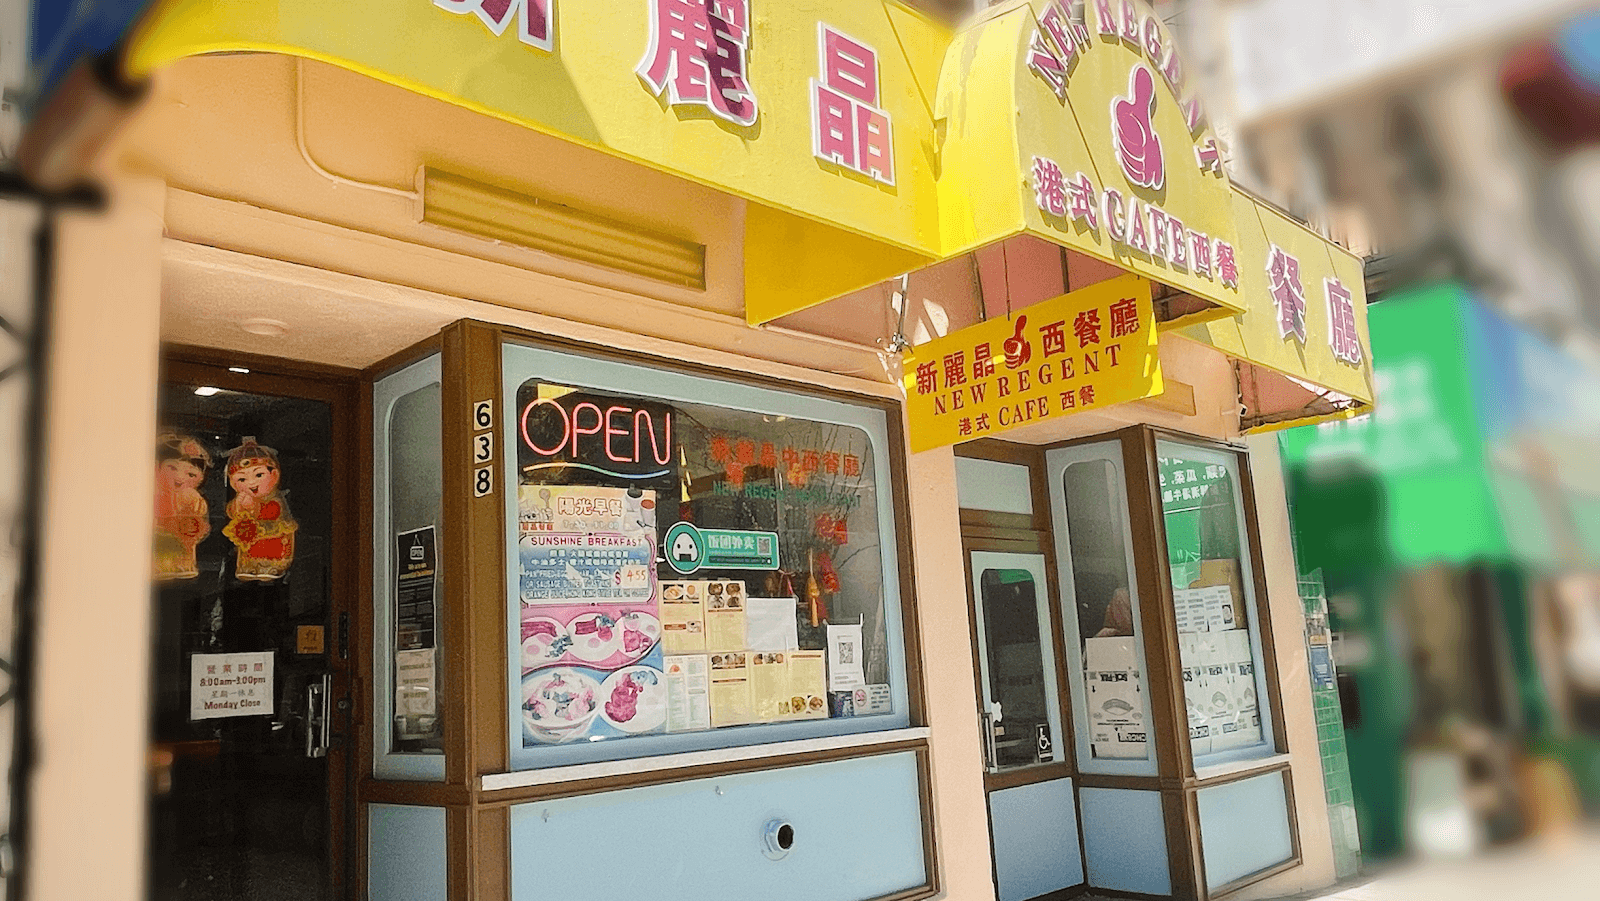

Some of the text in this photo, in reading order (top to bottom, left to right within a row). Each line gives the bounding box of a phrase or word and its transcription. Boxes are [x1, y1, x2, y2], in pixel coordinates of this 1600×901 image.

[1031, 155, 1239, 288] 港式 CAFE 西餐
[1265, 244, 1361, 363] 餐廳
[916, 298, 1140, 395] 新麗晶 西餐廳
[934, 344, 1121, 416] NEW REGENT
[522, 398, 671, 465] OPEN
[959, 385, 1095, 436] 港式 CAFE 西餐
[557, 497, 622, 517] 陽光早餐
[531, 536, 643, 547] SUNSHINE BREAKFAST
[204, 699, 261, 710] Monday Close
